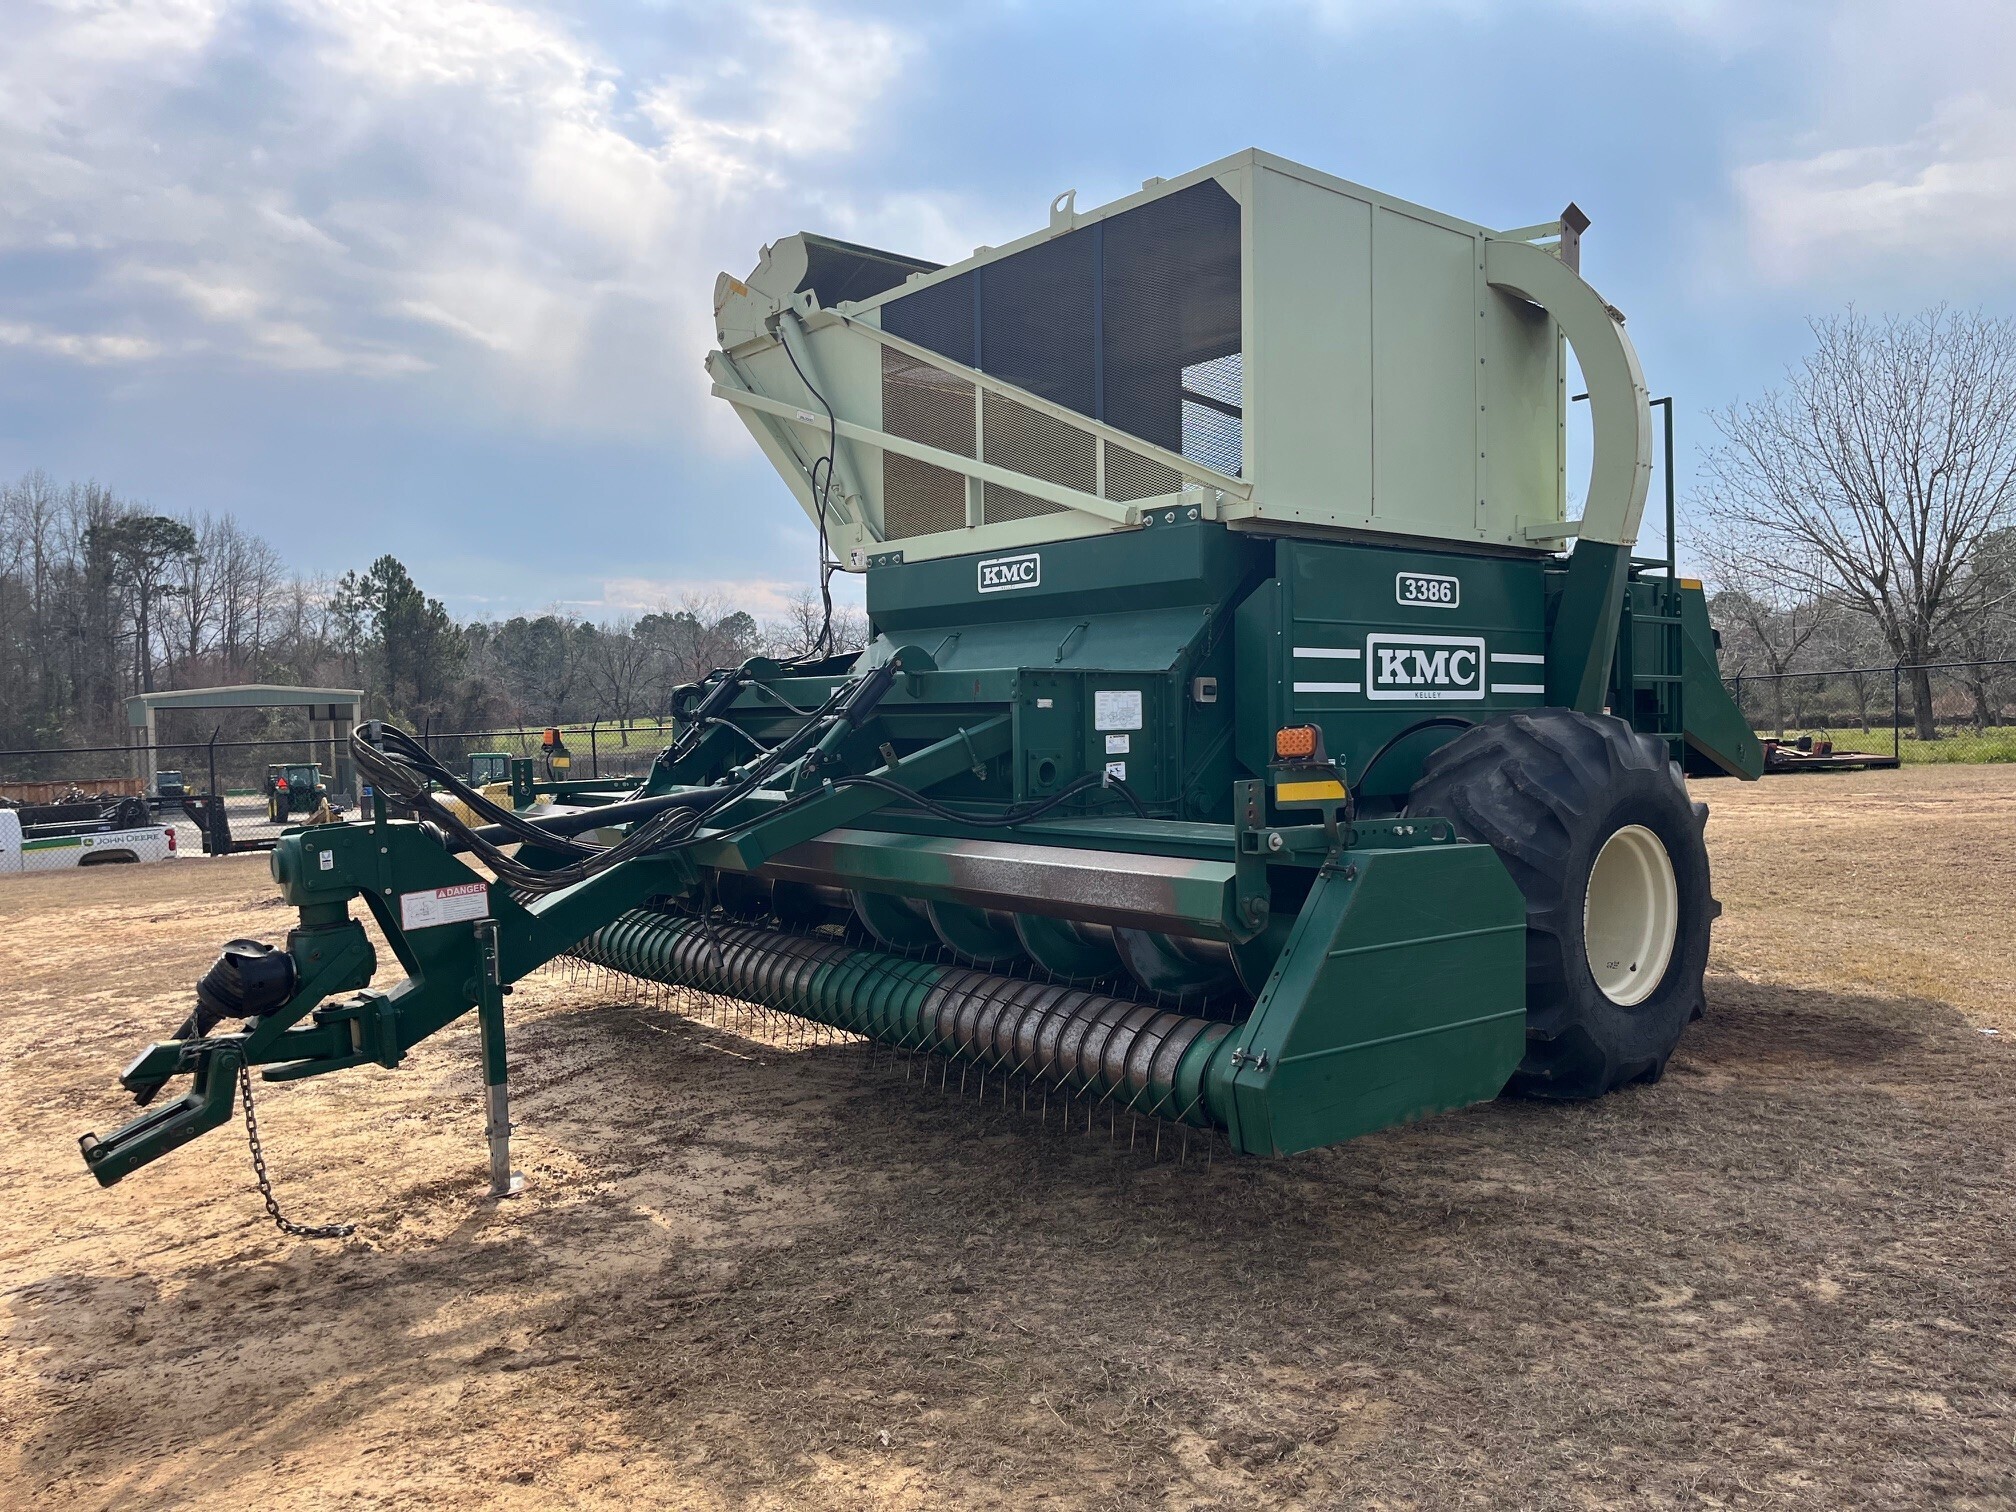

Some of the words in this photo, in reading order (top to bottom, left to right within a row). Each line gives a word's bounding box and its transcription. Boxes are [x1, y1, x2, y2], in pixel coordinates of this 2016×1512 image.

[983, 561, 1034, 586] KMC
[1405, 579, 1451, 602] 3386
[1377, 648, 1476, 686] KMC
[1414, 691, 1442, 699] KELLEY
[97, 835, 125, 846] JOHN
[126, 833, 160, 843] DEERE
[446, 883, 487, 897] DANGER
